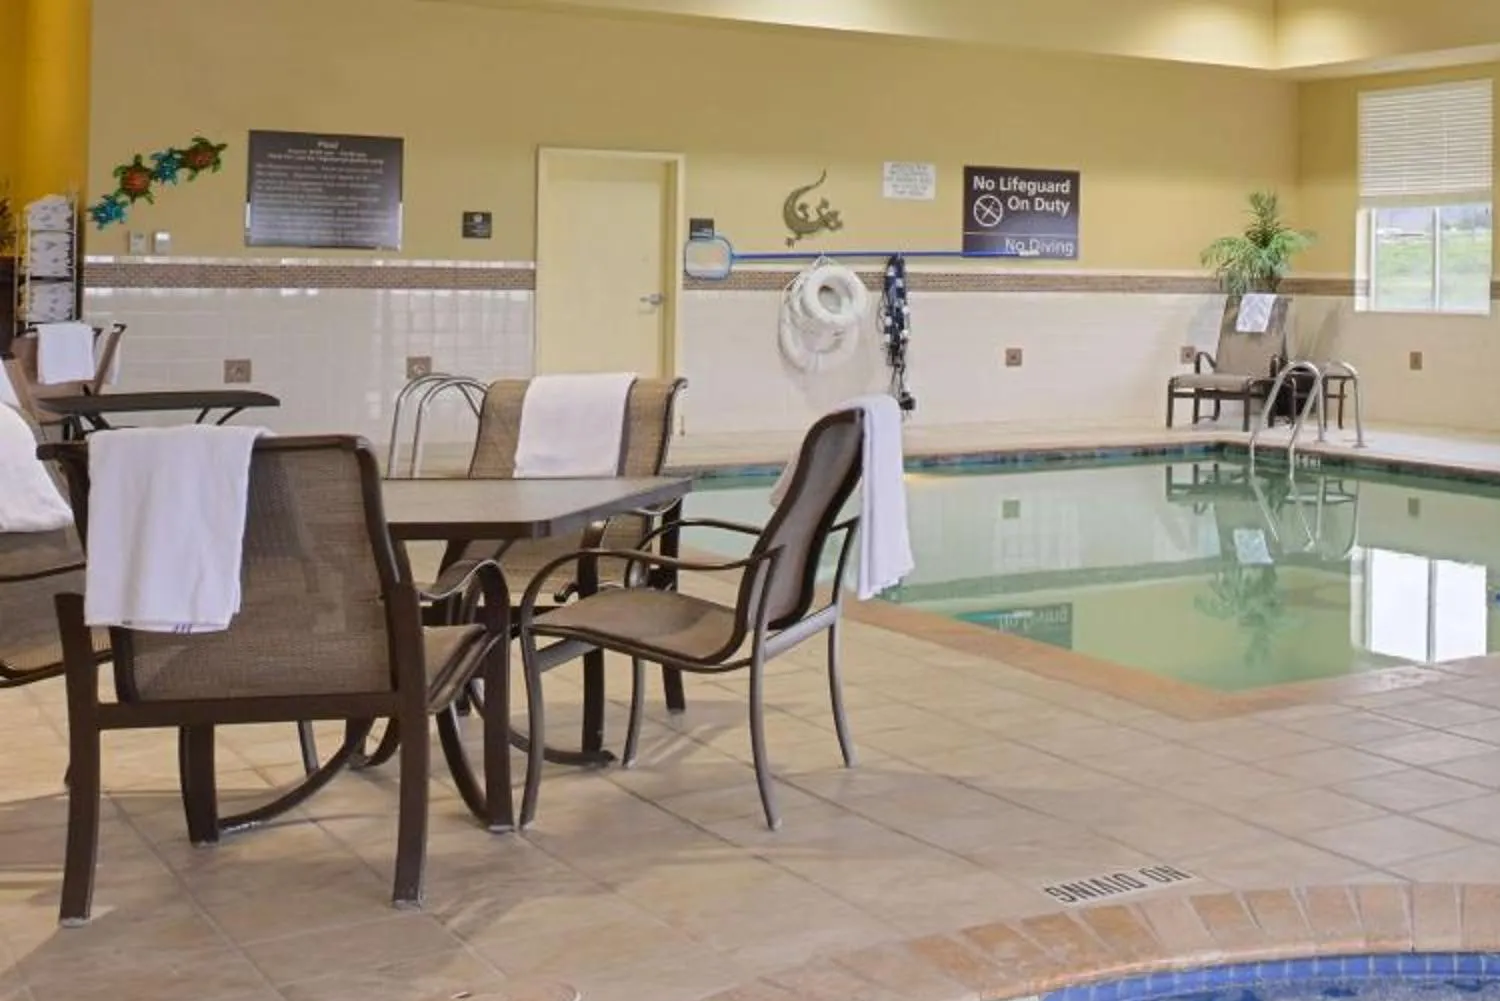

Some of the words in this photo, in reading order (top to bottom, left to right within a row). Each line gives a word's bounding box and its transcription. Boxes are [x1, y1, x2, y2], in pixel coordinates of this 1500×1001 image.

[973, 175, 995, 191] No
[1000, 177, 1071, 196] Lifeguard
[1007, 196, 1029, 211] On
[1034, 197, 1071, 217] Duty
[1005, 238, 1025, 254] No
[1029, 238, 1074, 257] Diving
